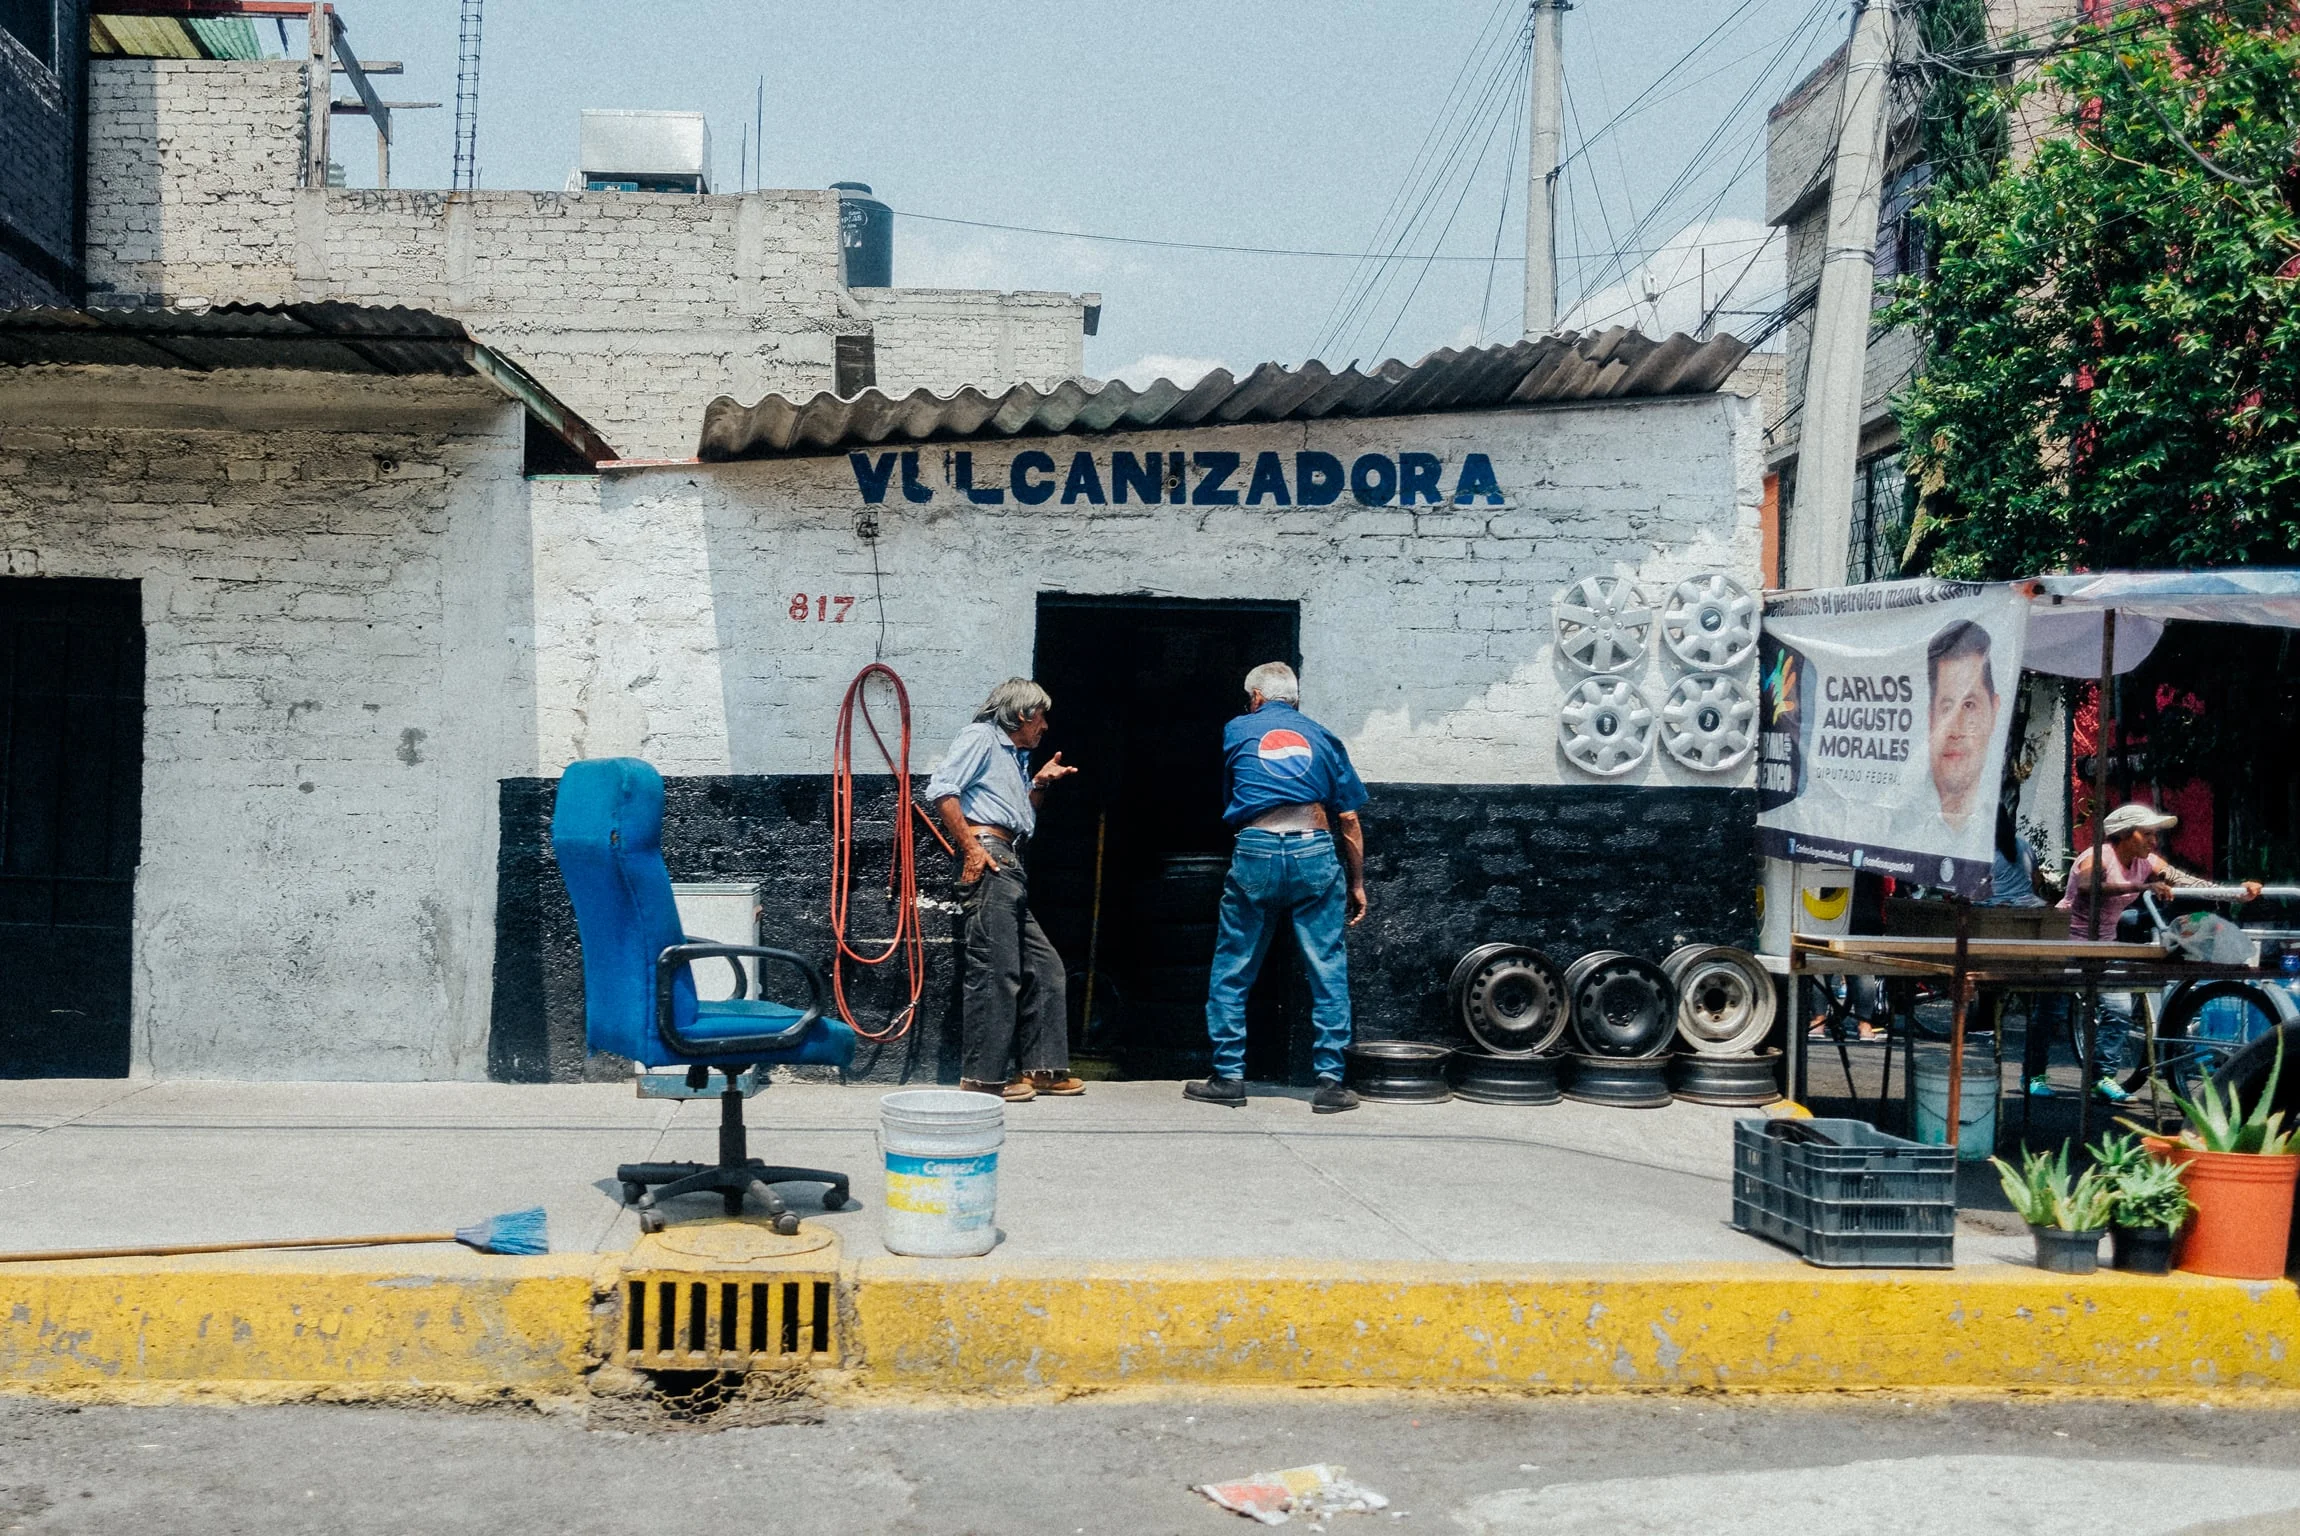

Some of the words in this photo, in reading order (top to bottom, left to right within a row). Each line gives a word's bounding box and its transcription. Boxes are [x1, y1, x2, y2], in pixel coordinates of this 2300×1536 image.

[849, 450, 1505, 508] VULCANIZADORA
[788, 592, 855, 623] 817
[1821, 591, 1832, 614] el
[1825, 675, 1913, 703] CARLOS
[1822, 707, 1913, 732] AUGUSTO
[1818, 735, 1910, 762] MORALES
[1816, 767, 1861, 782] DIPUTADO
